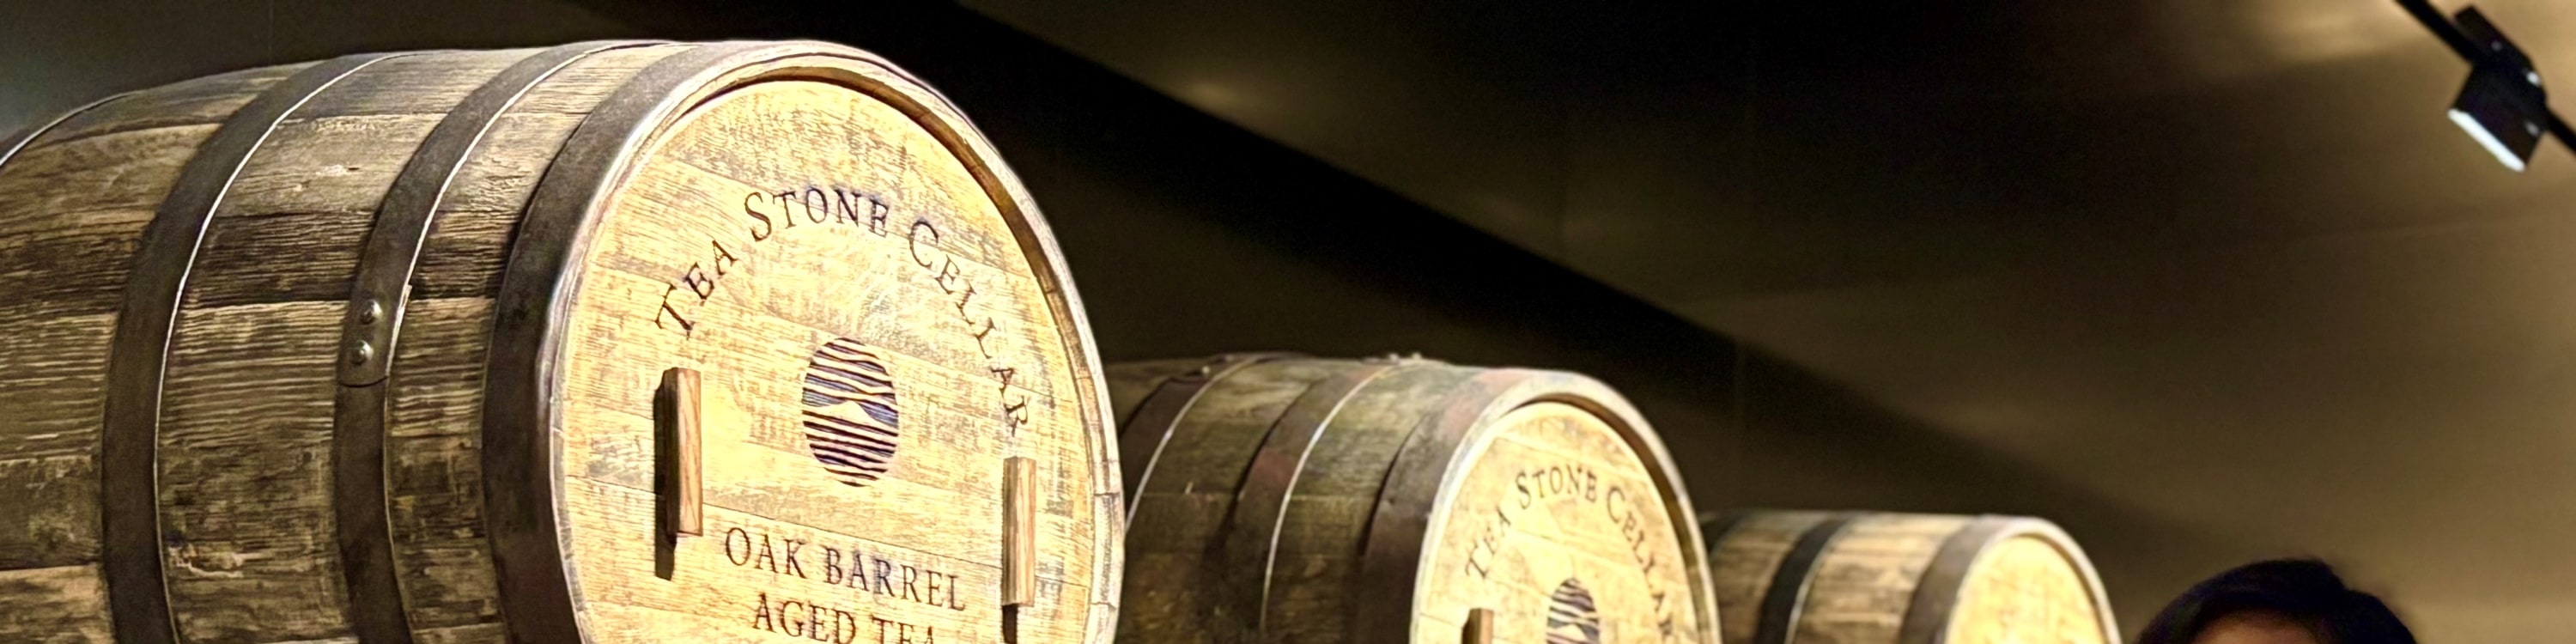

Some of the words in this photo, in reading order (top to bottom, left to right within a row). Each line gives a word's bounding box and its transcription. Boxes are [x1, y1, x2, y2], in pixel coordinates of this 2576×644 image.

[654, 240, 738, 339] TEA
[744, 187, 890, 243] STONE
[909, 220, 1030, 437] CELLAR
[726, 527, 807, 579] OAK
[824, 545, 966, 611] BARREL
[1465, 507, 1511, 580] TEA
[1515, 464, 1597, 510] STONE
[753, 592, 856, 644] AGED
